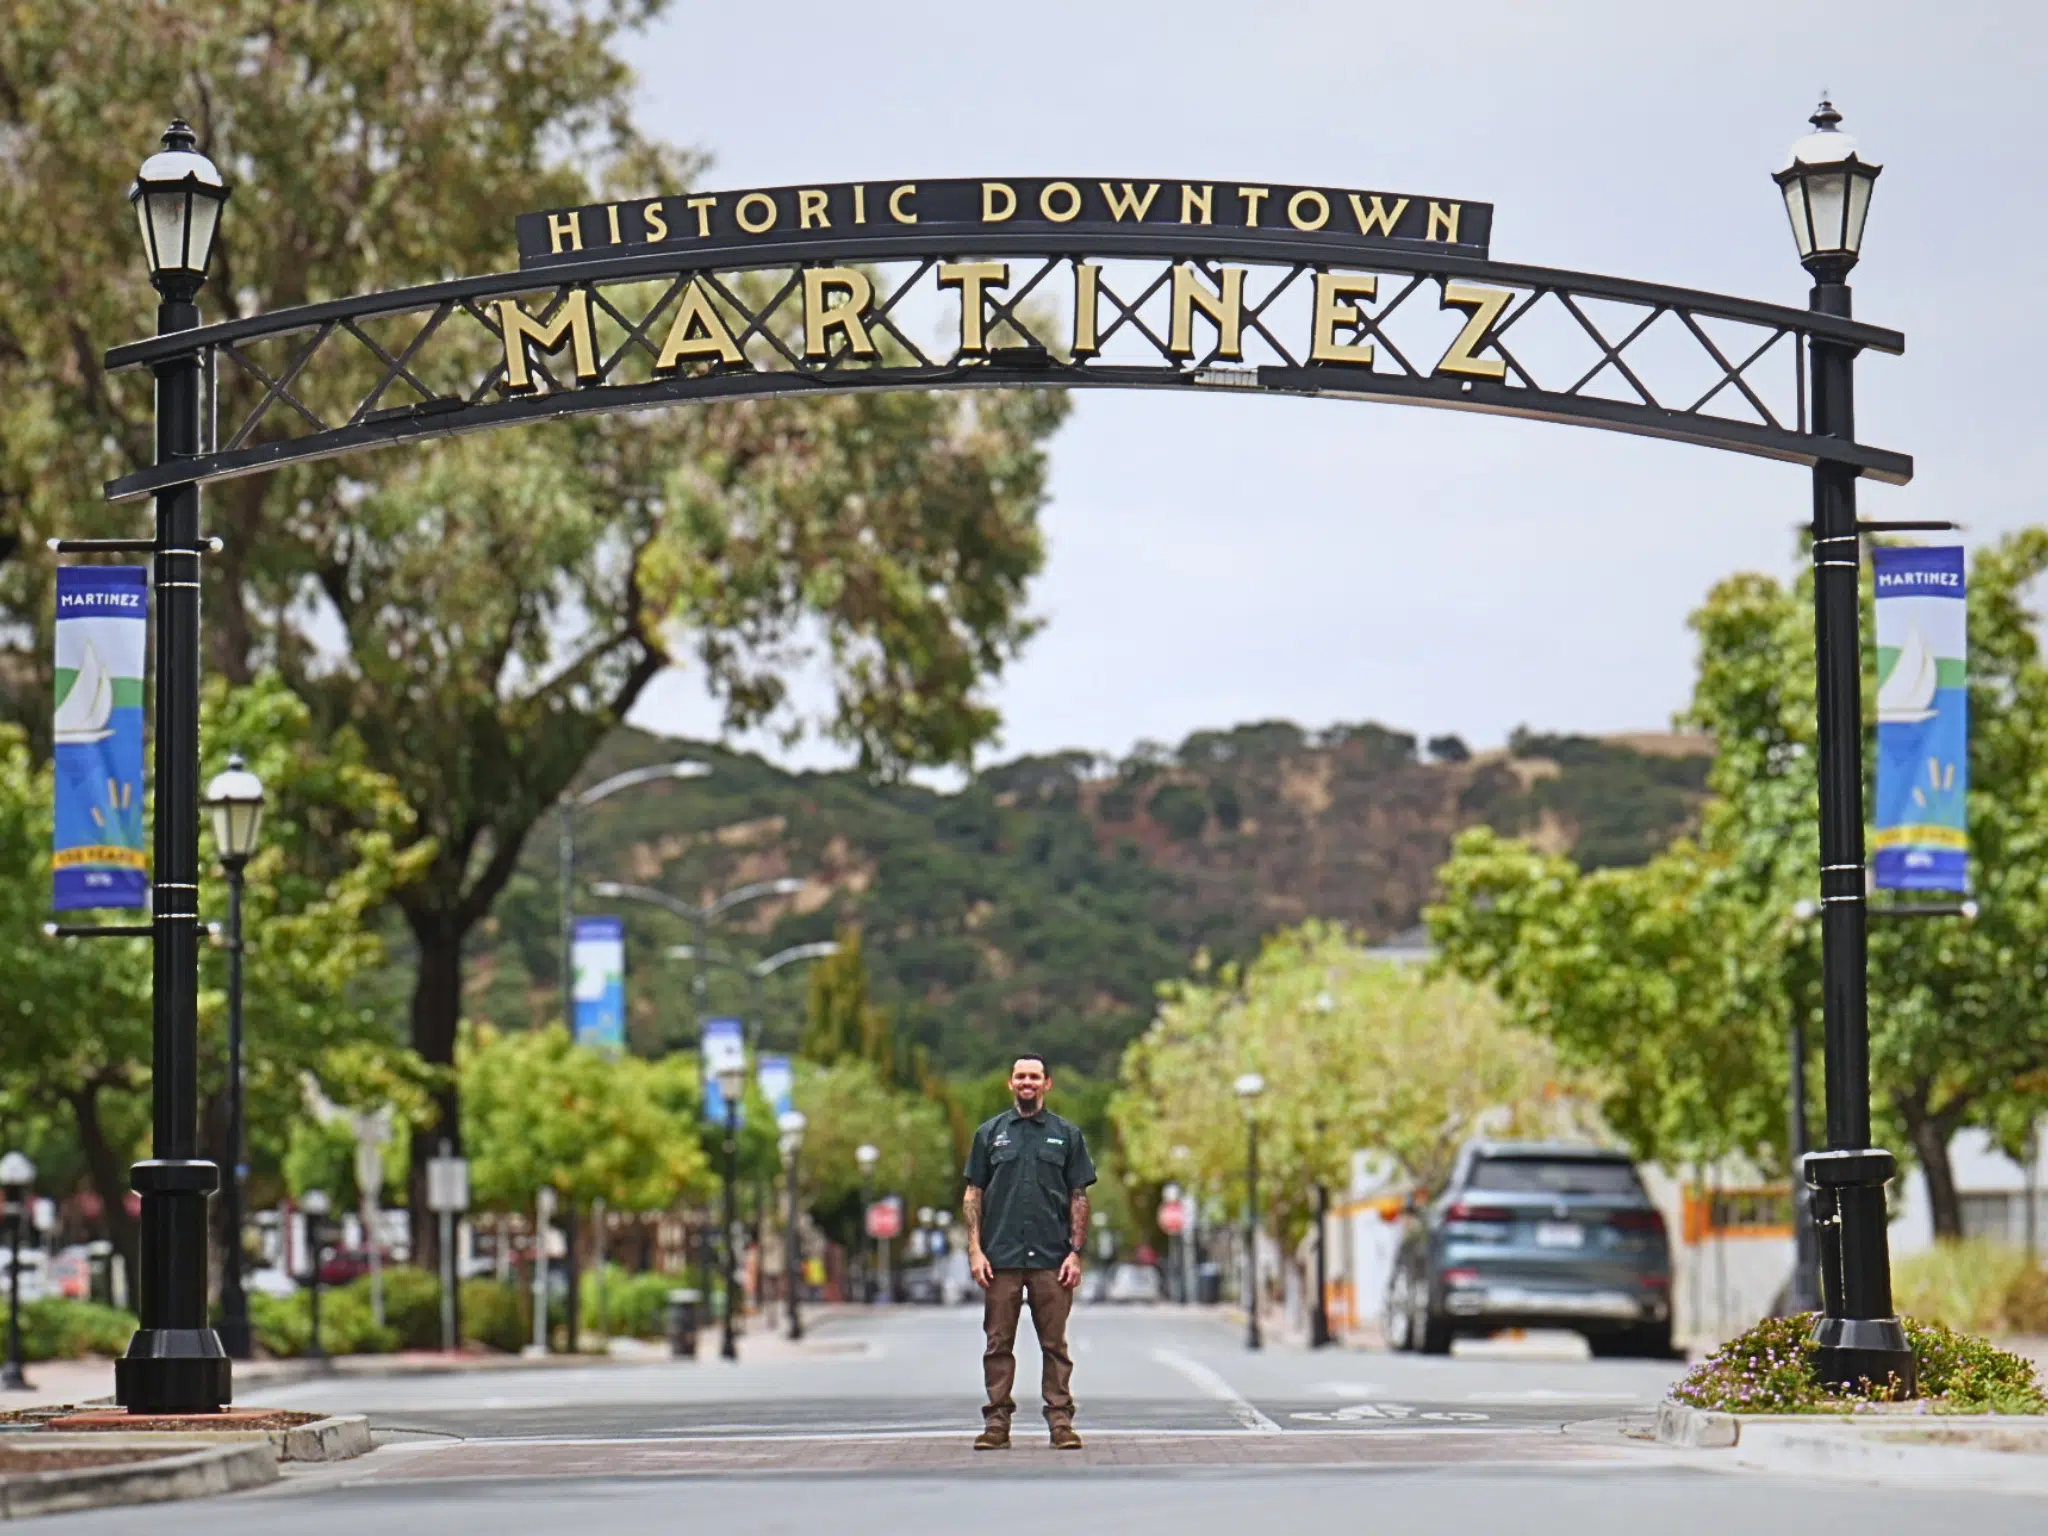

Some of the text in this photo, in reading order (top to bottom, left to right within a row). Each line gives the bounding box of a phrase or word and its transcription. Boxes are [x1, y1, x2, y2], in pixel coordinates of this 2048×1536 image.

[547, 181, 1462, 253] HISTORIC DOWNTOWN
[497, 263, 1512, 388] MARTINEZ
[60, 592, 140, 607] MARTINEZ
[1878, 571, 1959, 587] MARTINEZ
